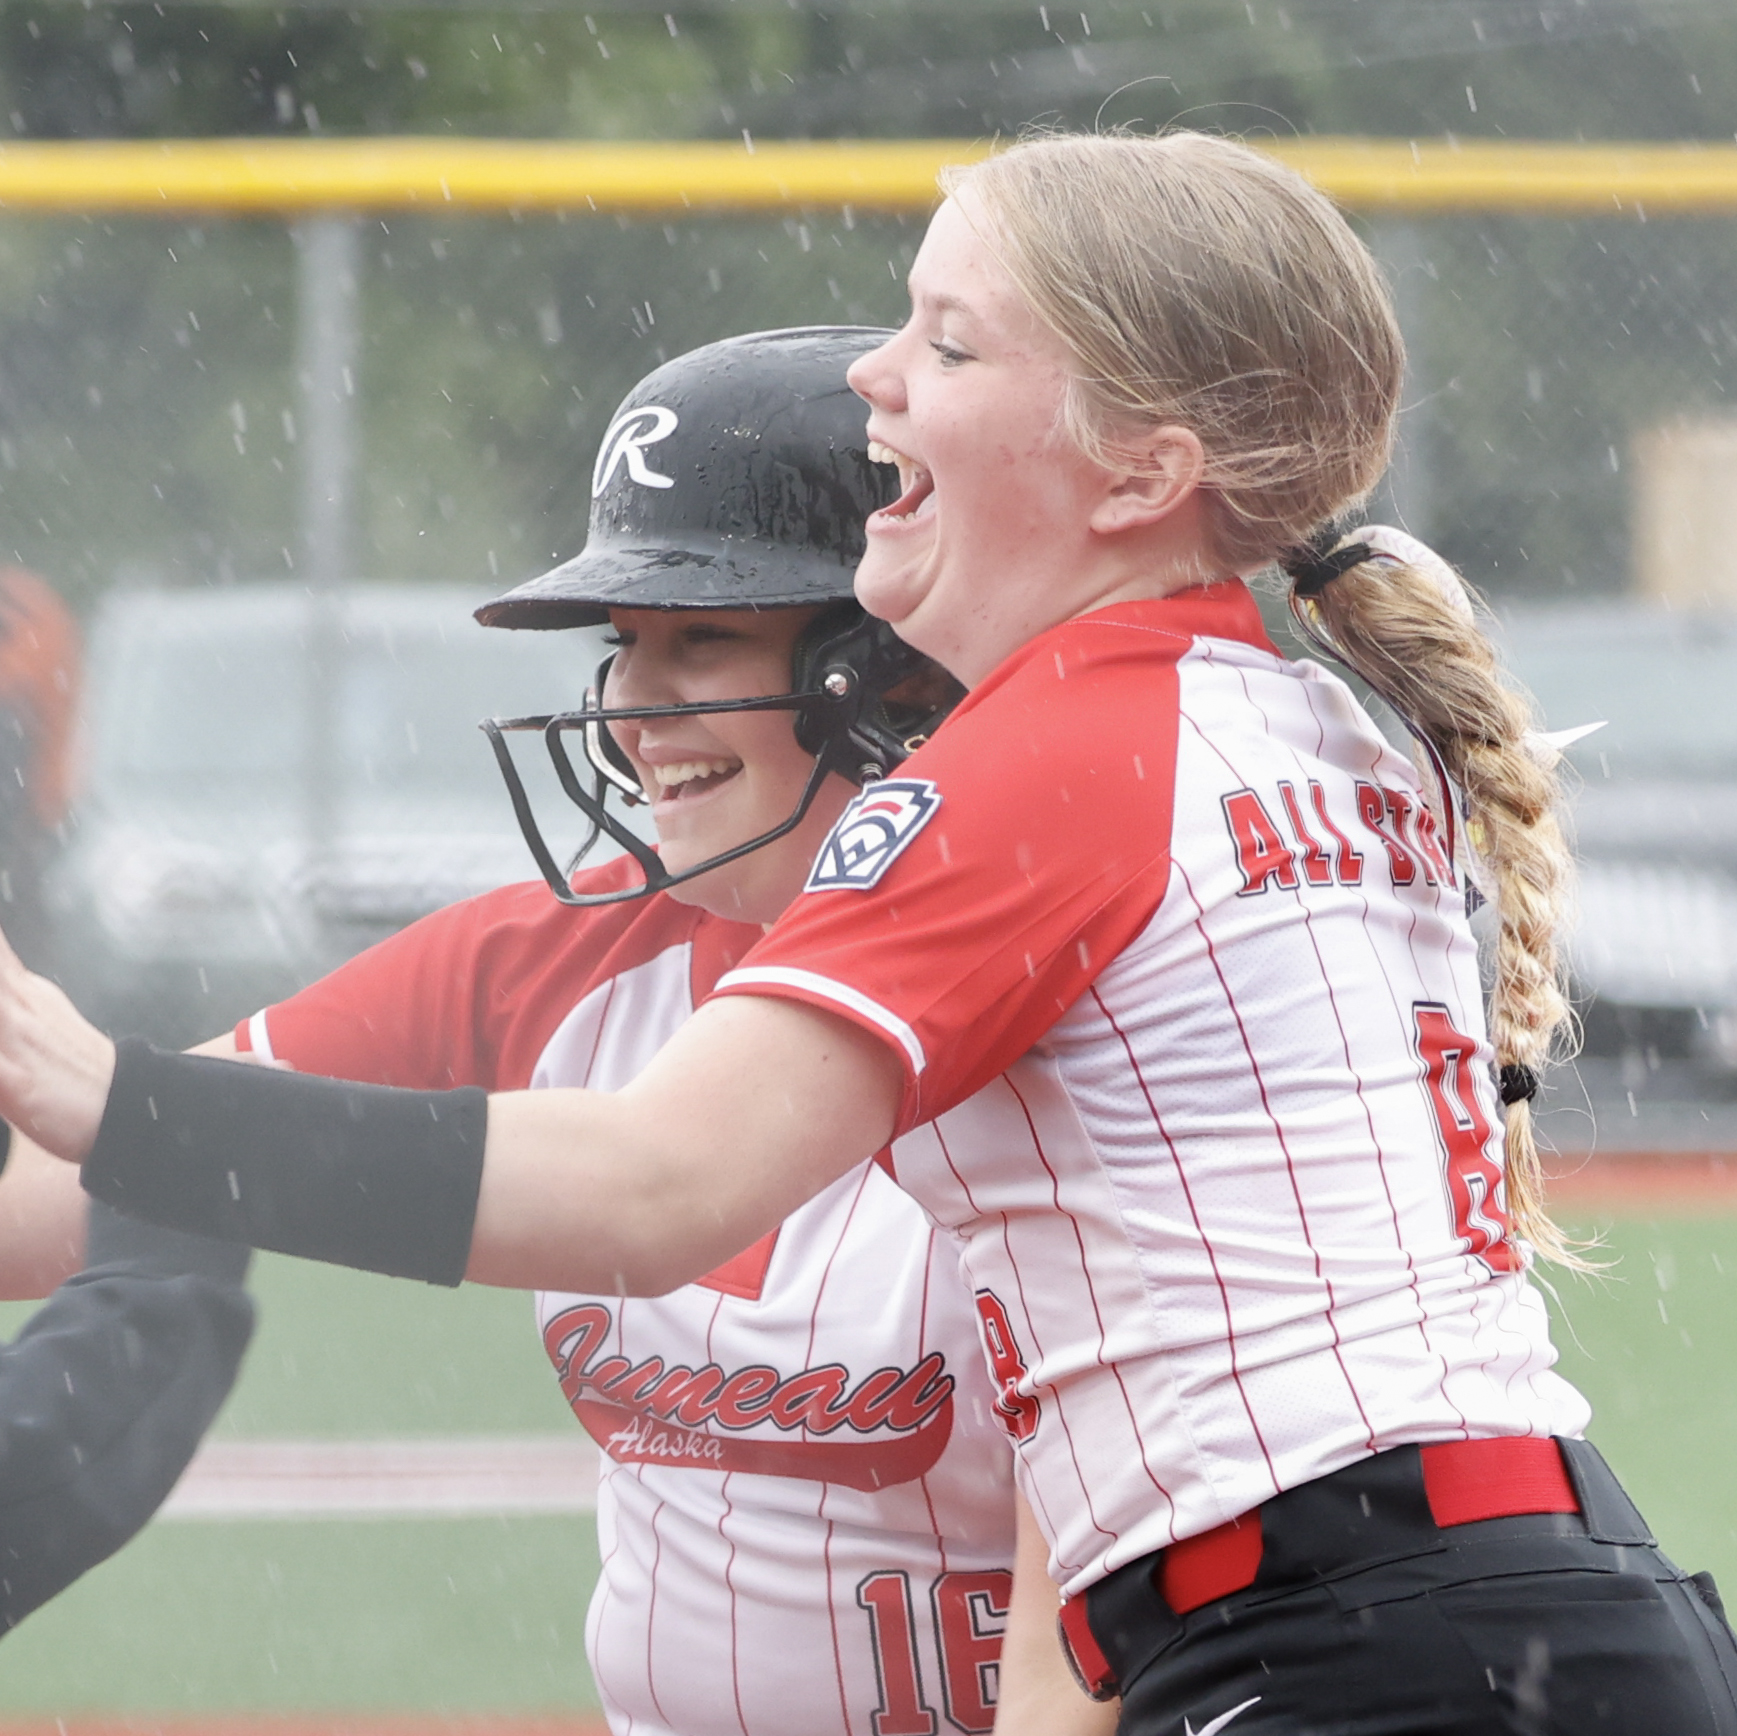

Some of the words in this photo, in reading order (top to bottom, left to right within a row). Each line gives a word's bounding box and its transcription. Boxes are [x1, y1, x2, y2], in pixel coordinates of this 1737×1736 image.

[592, 405, 678, 498] R
[1220, 779, 1365, 898] ALL
[1355, 779, 1457, 892] STA
[543, 1303, 955, 1436] Juneau
[605, 1415, 723, 1461] Alaska
